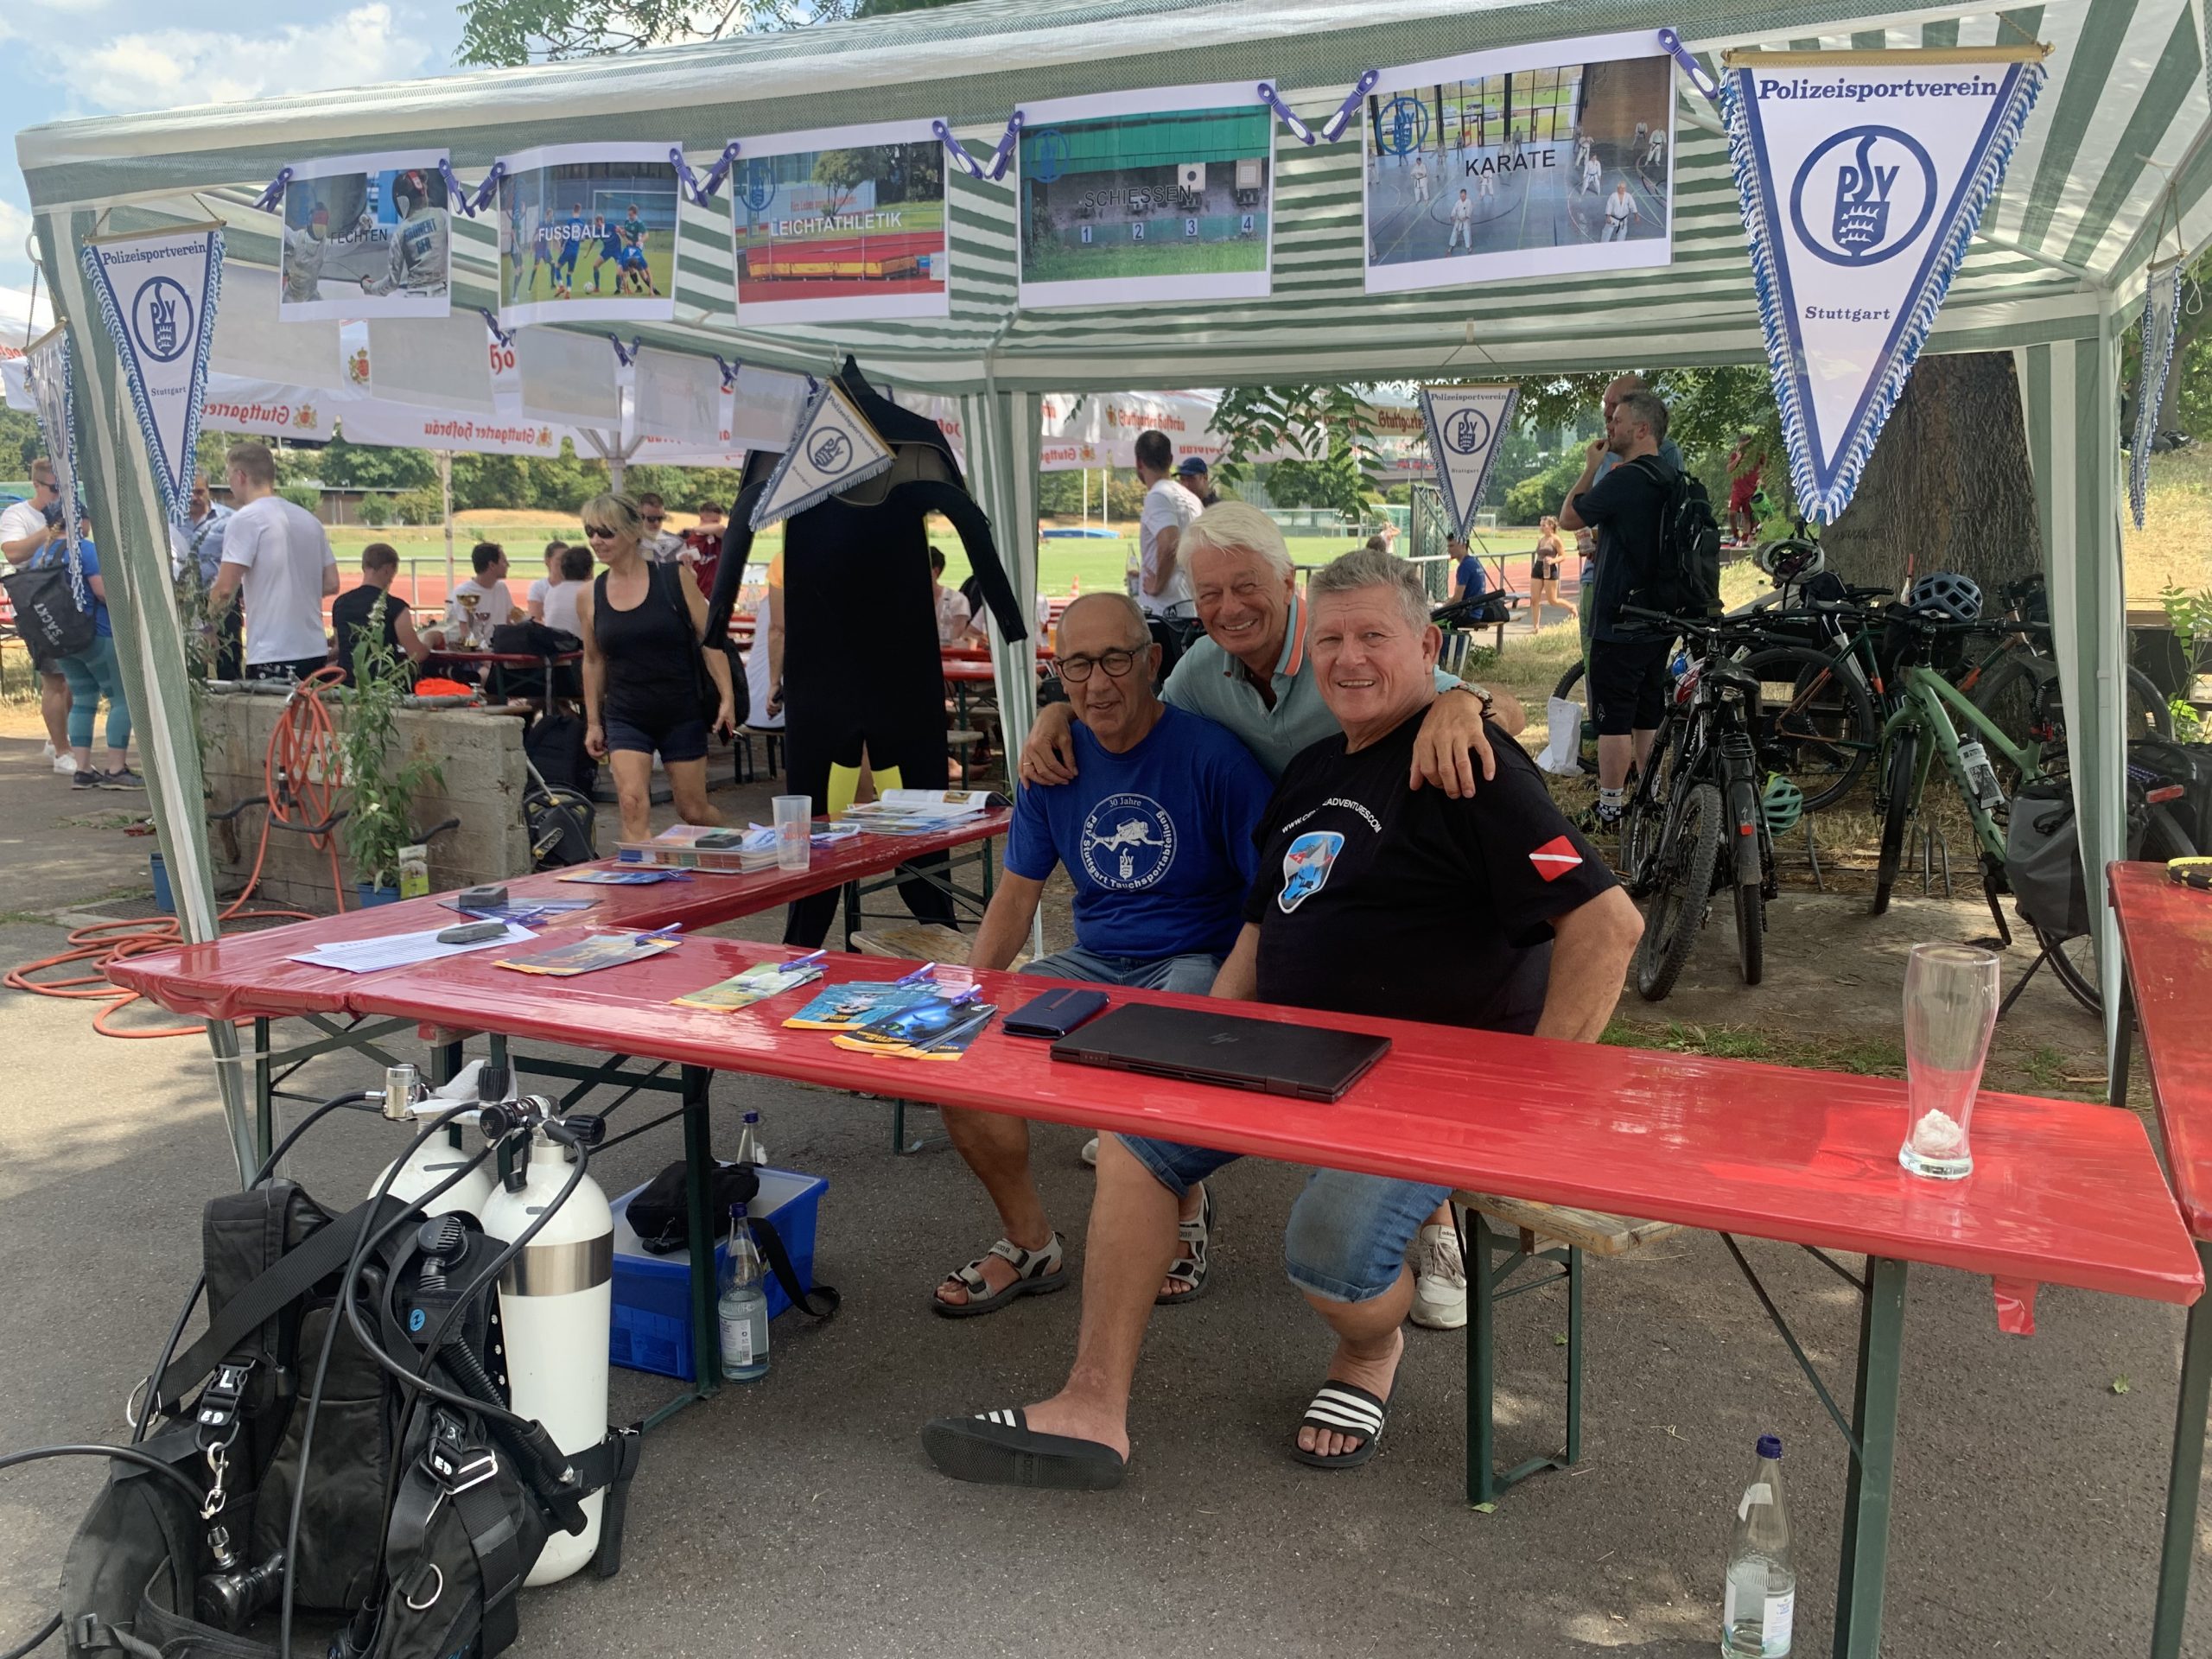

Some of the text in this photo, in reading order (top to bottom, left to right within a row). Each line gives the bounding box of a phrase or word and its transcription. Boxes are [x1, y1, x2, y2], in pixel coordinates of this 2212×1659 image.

[1758, 75, 1997, 102] Polizeisportverein
[1466, 149, 1555, 177] KARATE
[1084, 185, 1192, 208] SCHIESSEN
[538, 225, 609, 242] FUSSBALL
[771, 213, 901, 236] LEICHTATHLETIK
[1083, 217, 1251, 242] 1 2 3 4
[330, 229, 387, 244] FECHTEN
[102, 241, 207, 265] Polizeisportverein
[1805, 307, 1890, 321] Stuttgart
[151, 386, 186, 397] Stuttgart
[1431, 392, 1507, 402] Polizeisportverein
[1109, 798, 1141, 808] 30 Jahre
[1084, 839, 1109, 884] Stuttgart
[1110, 810, 1172, 889] Tauchsportabteilung
[219, 1370, 232, 1388] L
